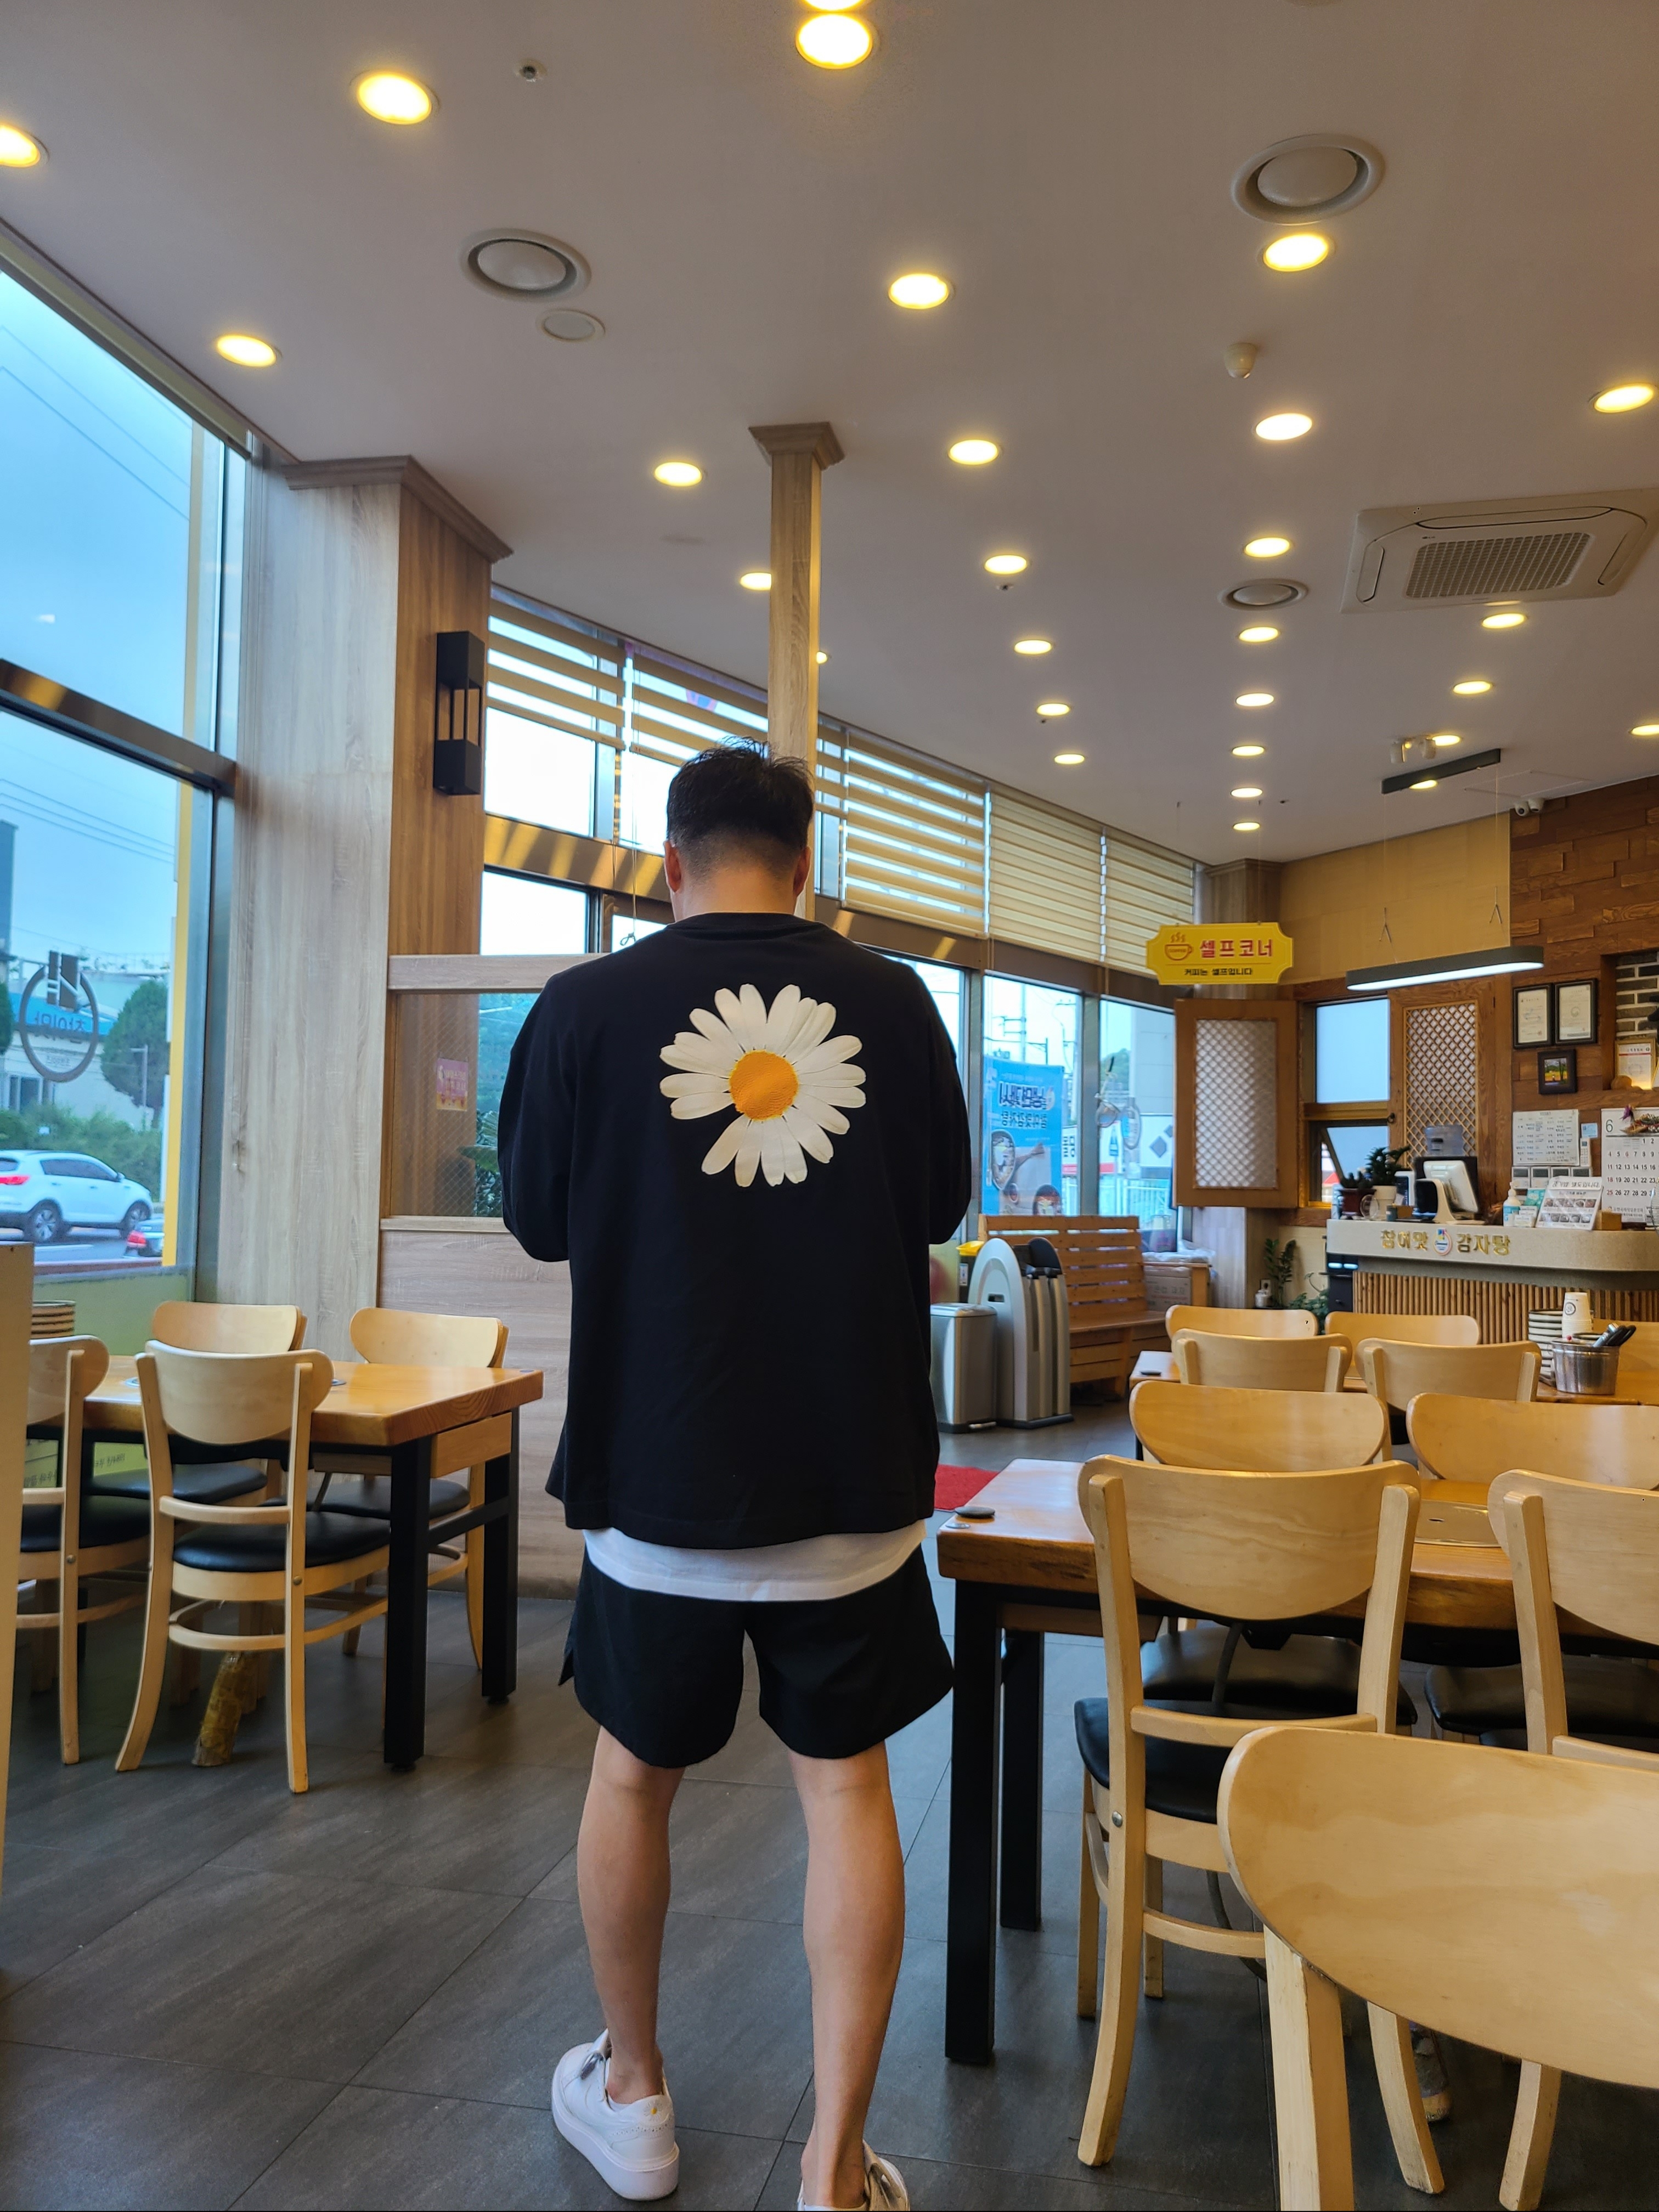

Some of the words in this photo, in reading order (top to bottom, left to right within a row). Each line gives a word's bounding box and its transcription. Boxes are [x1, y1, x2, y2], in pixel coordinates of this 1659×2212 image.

[1200, 939, 1273, 958] 셀프코너
[1606, 1119, 1613, 1132] 6
[1381, 1229, 1428, 1250] 참이맛
[1457, 1233, 1510, 1255] 감자탕
